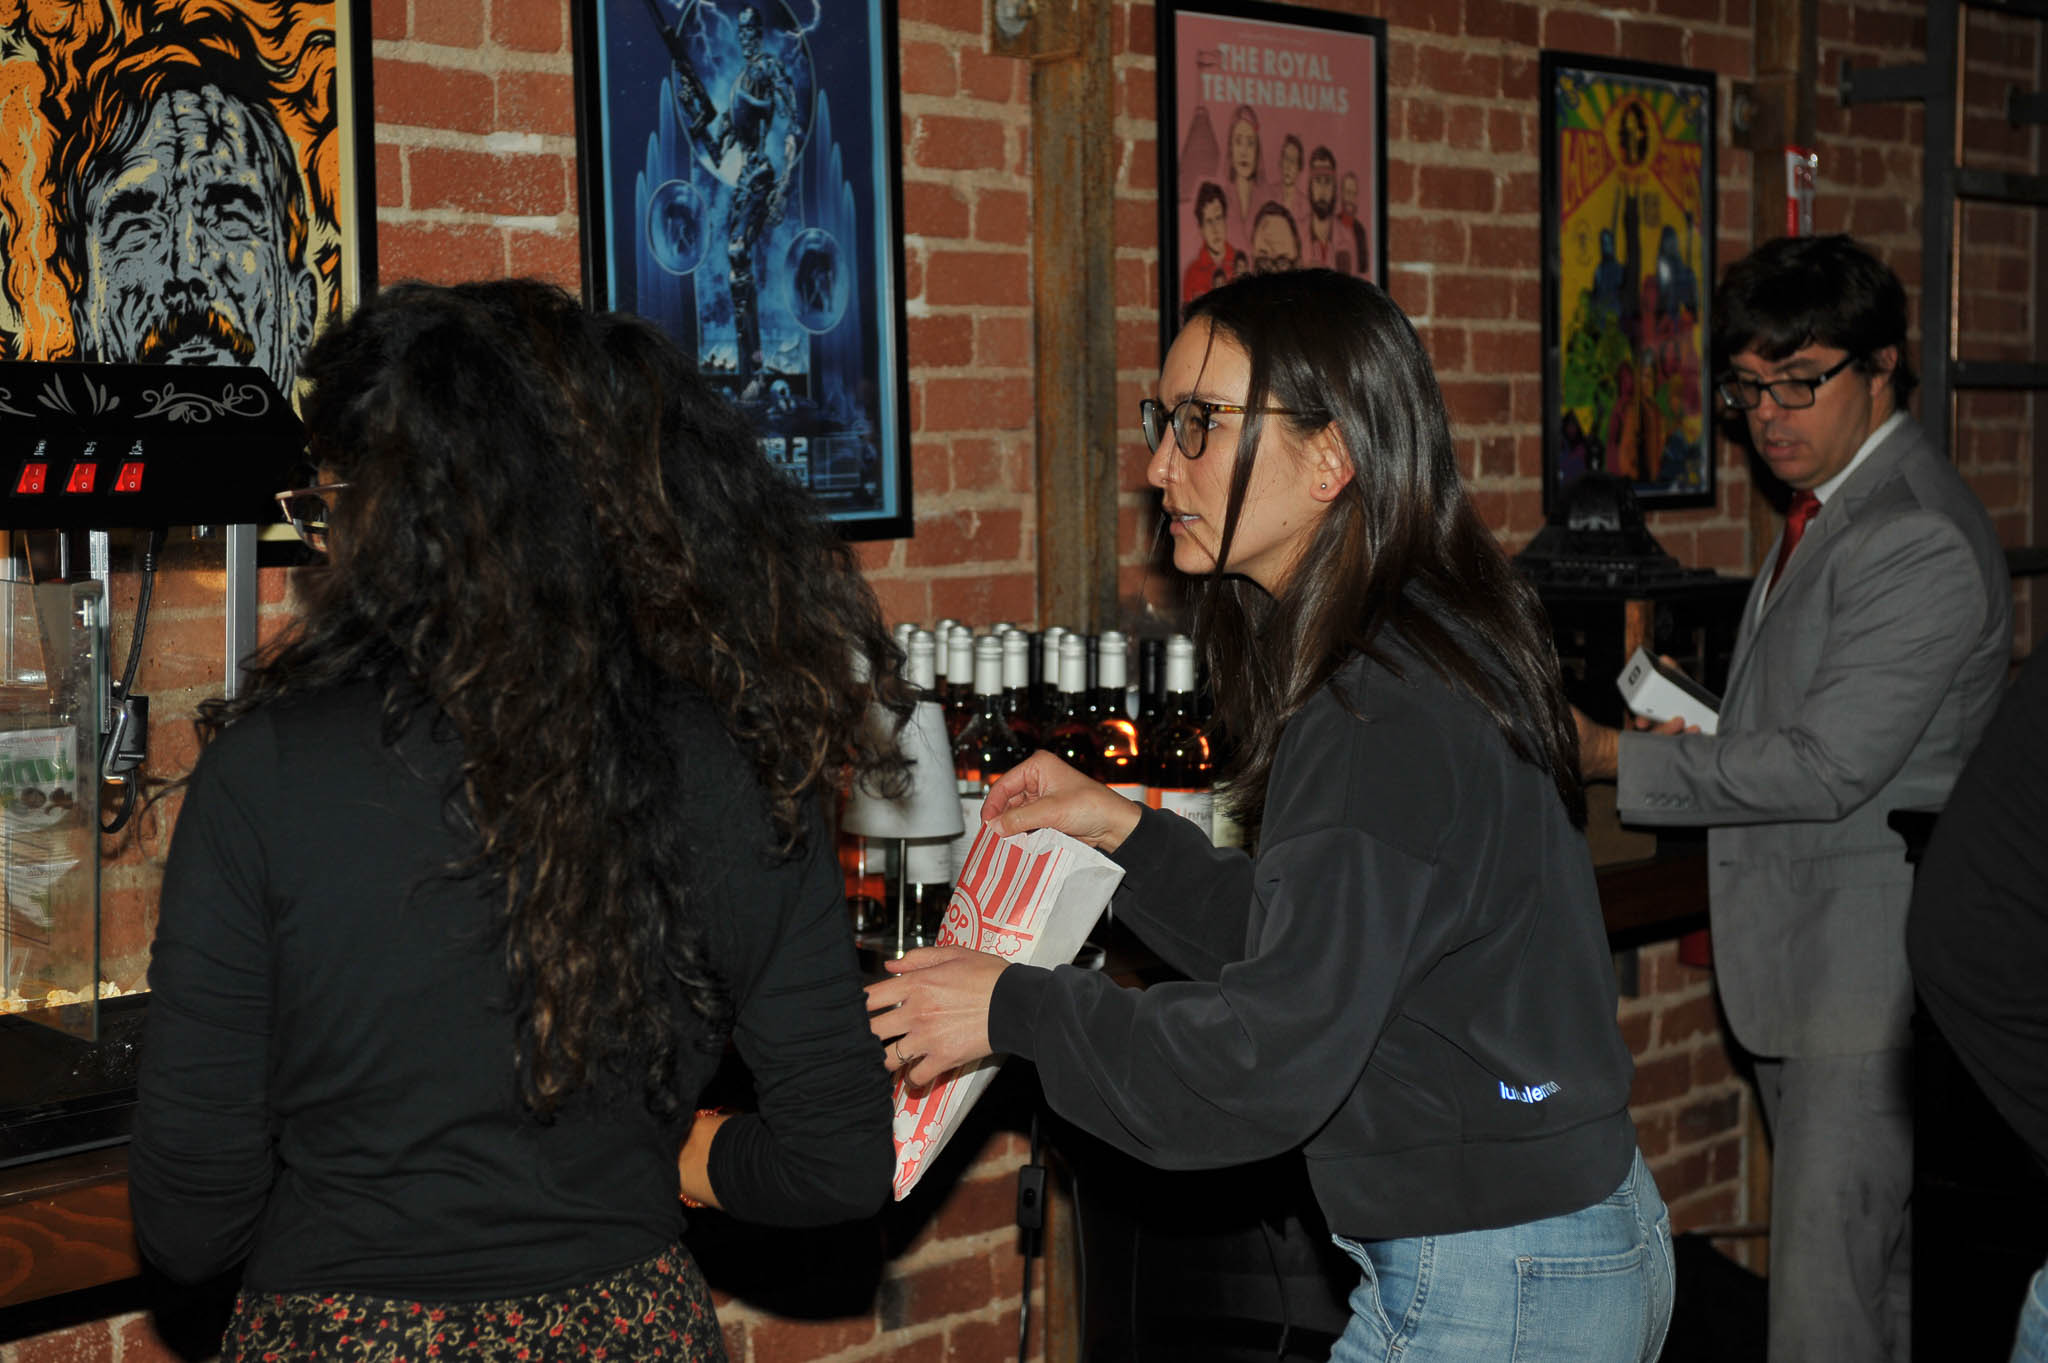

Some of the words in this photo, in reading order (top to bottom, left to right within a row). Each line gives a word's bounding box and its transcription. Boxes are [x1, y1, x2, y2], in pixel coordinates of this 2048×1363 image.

[1218, 42, 1259, 74] THE
[1264, 48, 1333, 82] ROYAL
[1201, 73, 1348, 114] TENENBAUMS
